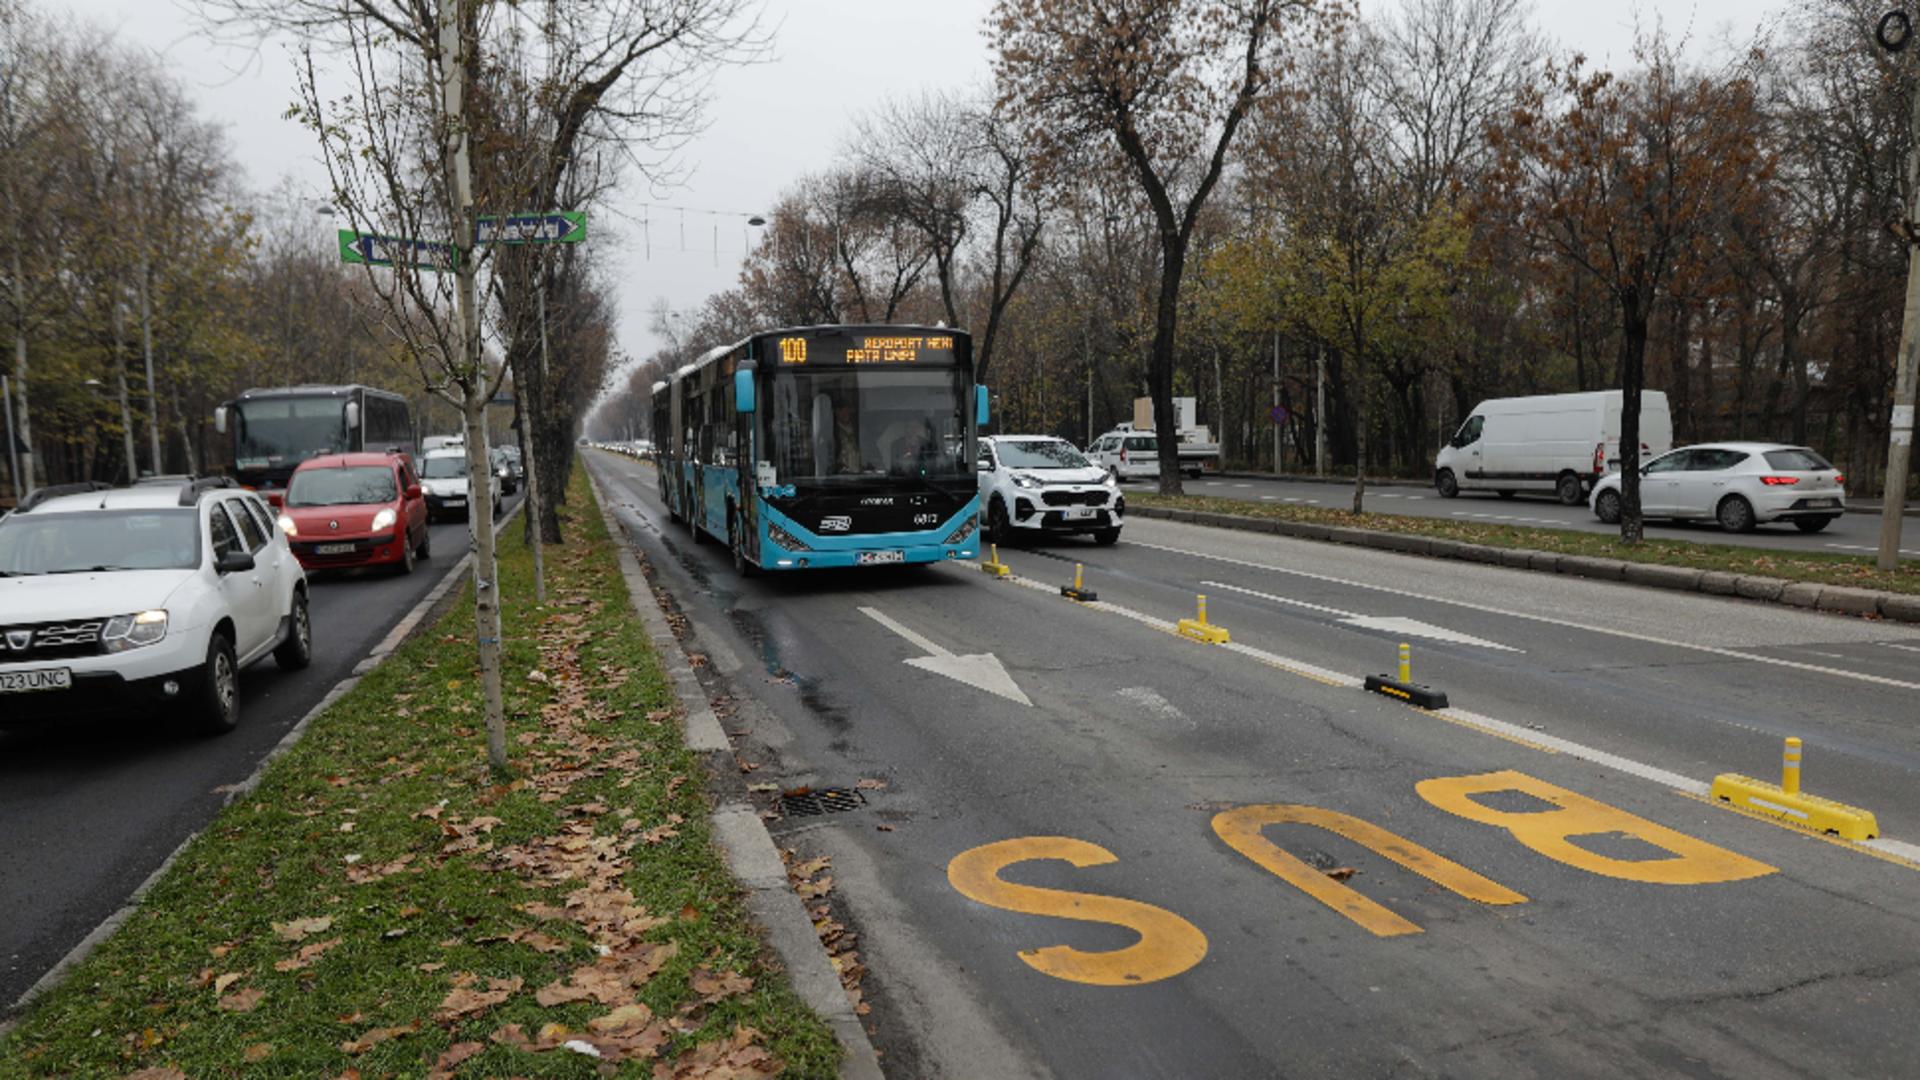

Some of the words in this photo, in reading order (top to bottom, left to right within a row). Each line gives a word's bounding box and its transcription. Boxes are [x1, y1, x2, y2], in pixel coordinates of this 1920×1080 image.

[779, 338, 807, 362] 100
[864, 337, 923, 349] AEROPORT
[27, 671, 66, 687] UNC
[947, 770, 1778, 986] BUS
